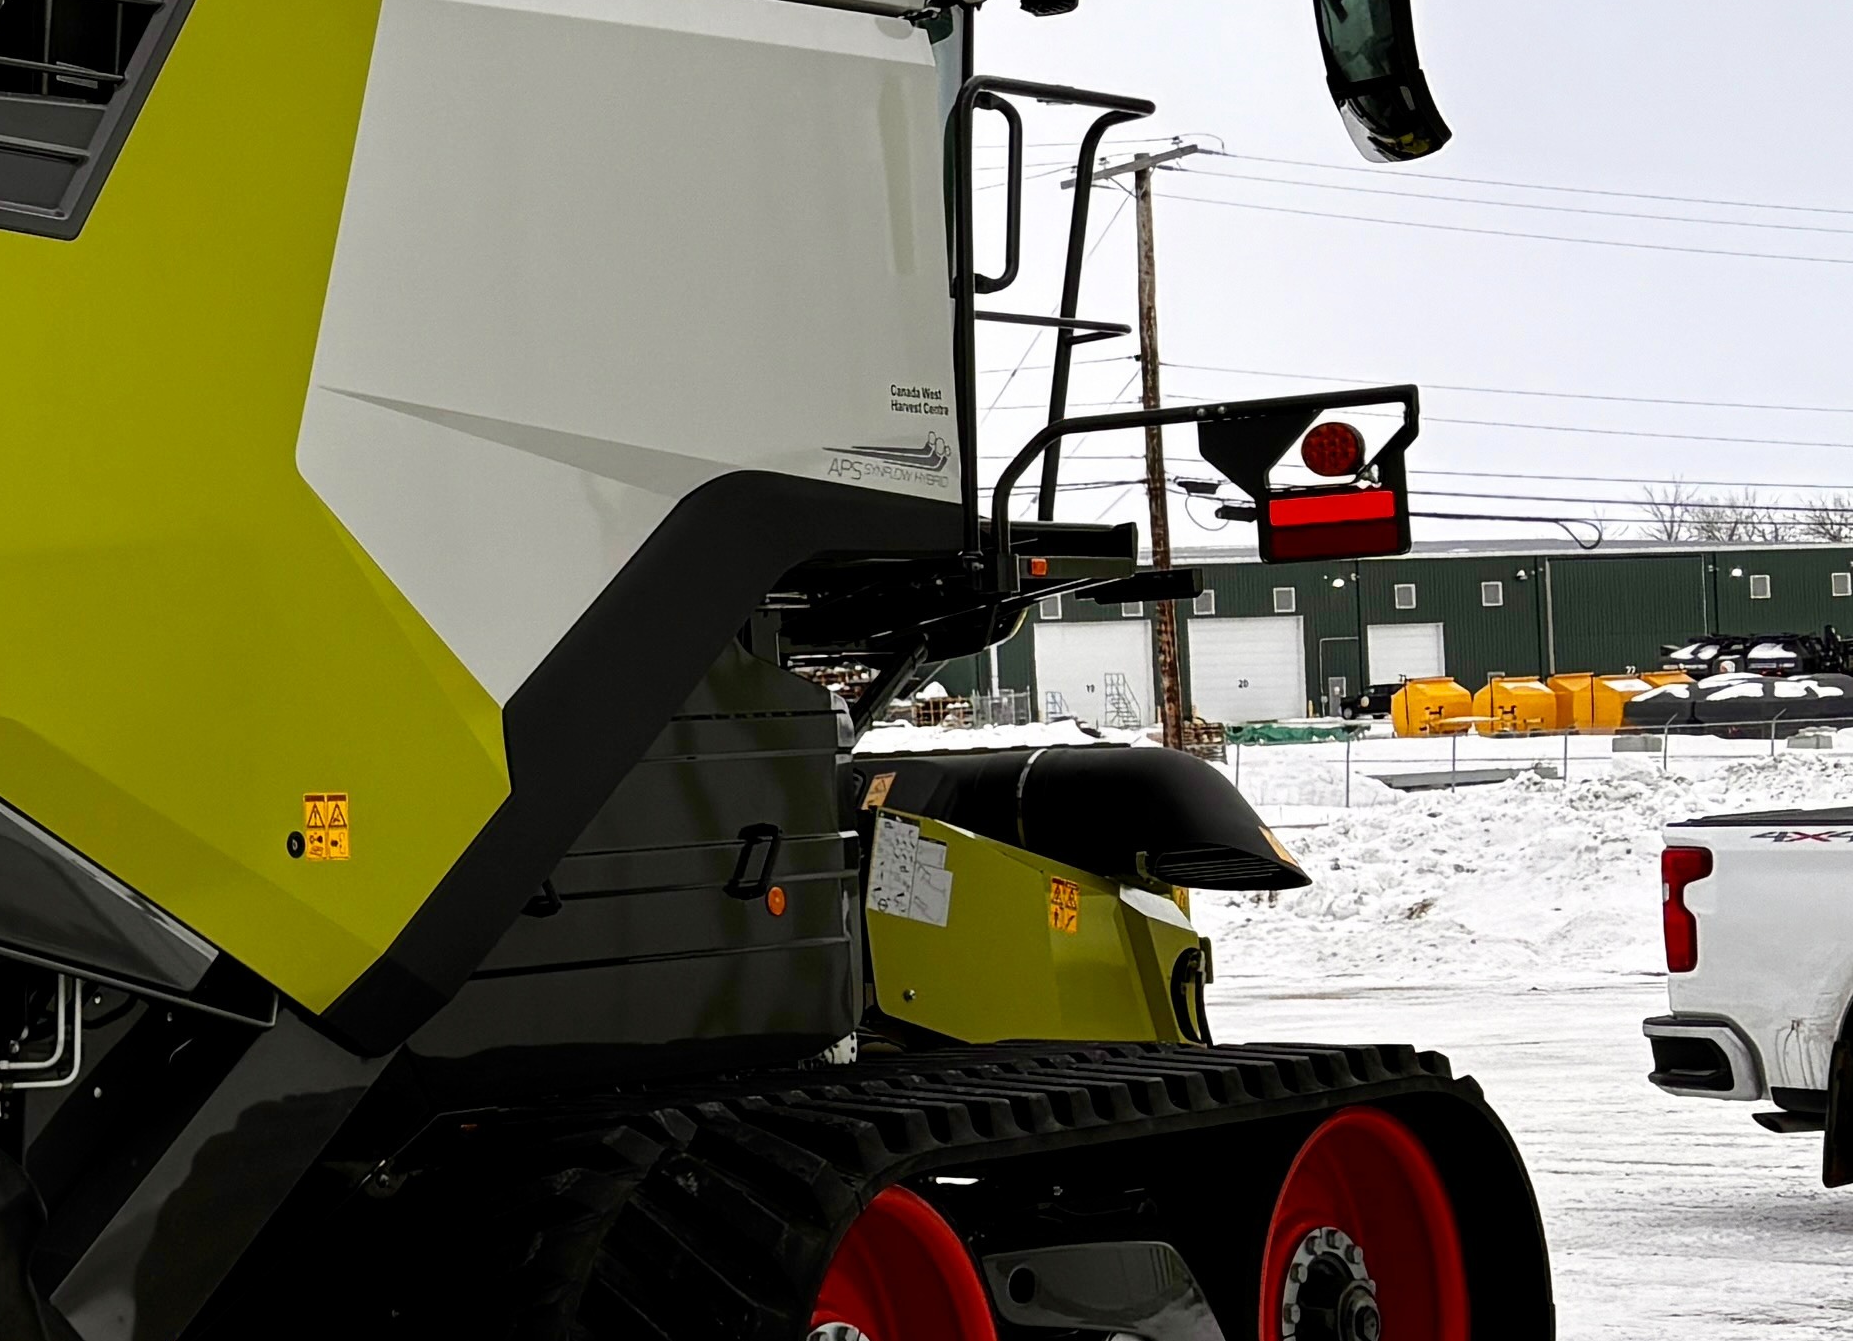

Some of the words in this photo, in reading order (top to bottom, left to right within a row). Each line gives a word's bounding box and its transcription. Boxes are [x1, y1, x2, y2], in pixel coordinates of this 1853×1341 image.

[890, 384, 920, 399] Canada
[922, 386, 942, 400] West
[890, 400, 922, 414] Harvest
[827, 457, 863, 480] APS
[1237, 678, 1250, 689] 20
